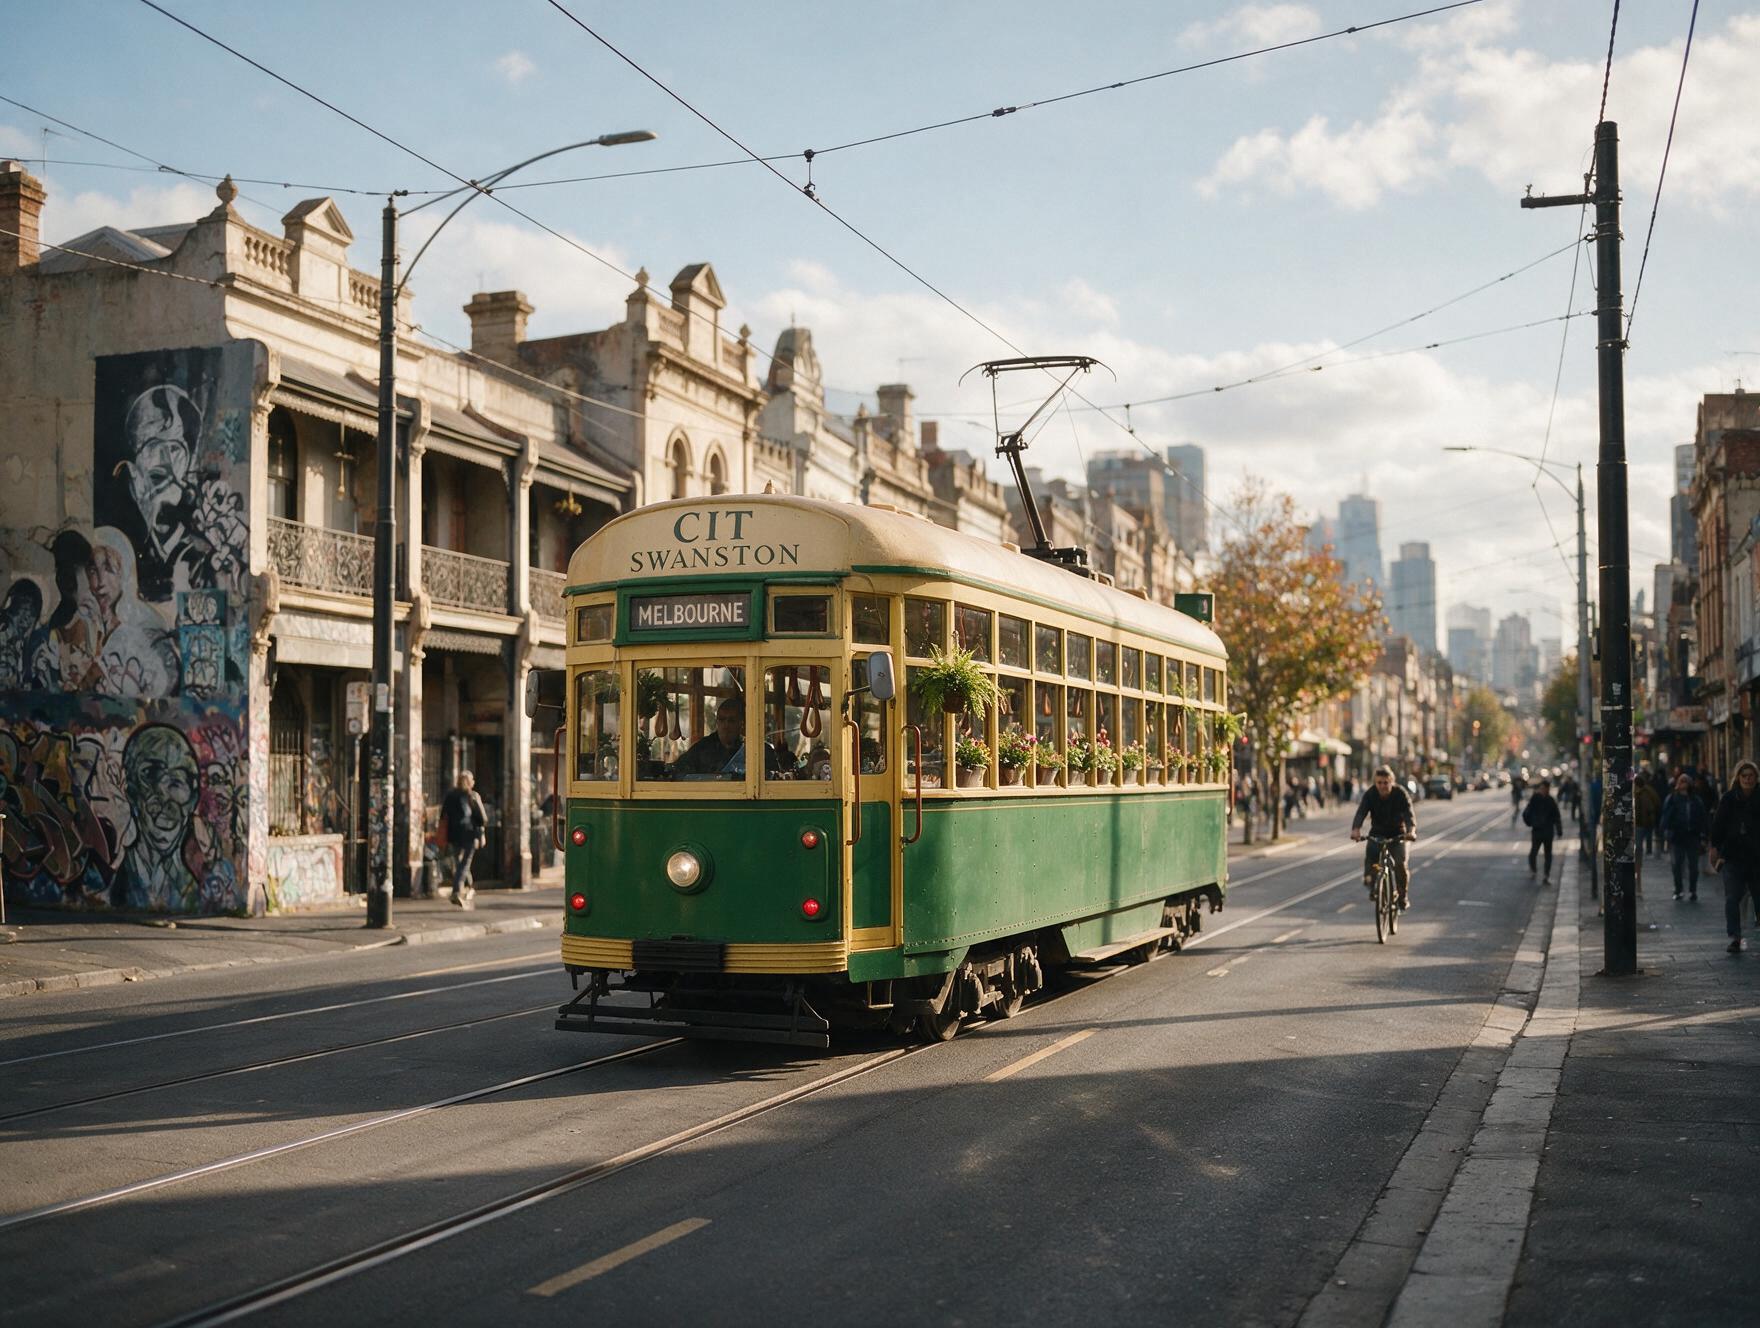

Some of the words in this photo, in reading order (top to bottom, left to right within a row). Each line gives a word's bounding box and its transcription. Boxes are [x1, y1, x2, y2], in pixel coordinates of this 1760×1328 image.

[673, 510, 753, 543] CIT
[630, 544, 800, 572] SWANSTON
[638, 602, 743, 626] MELBOURNE
